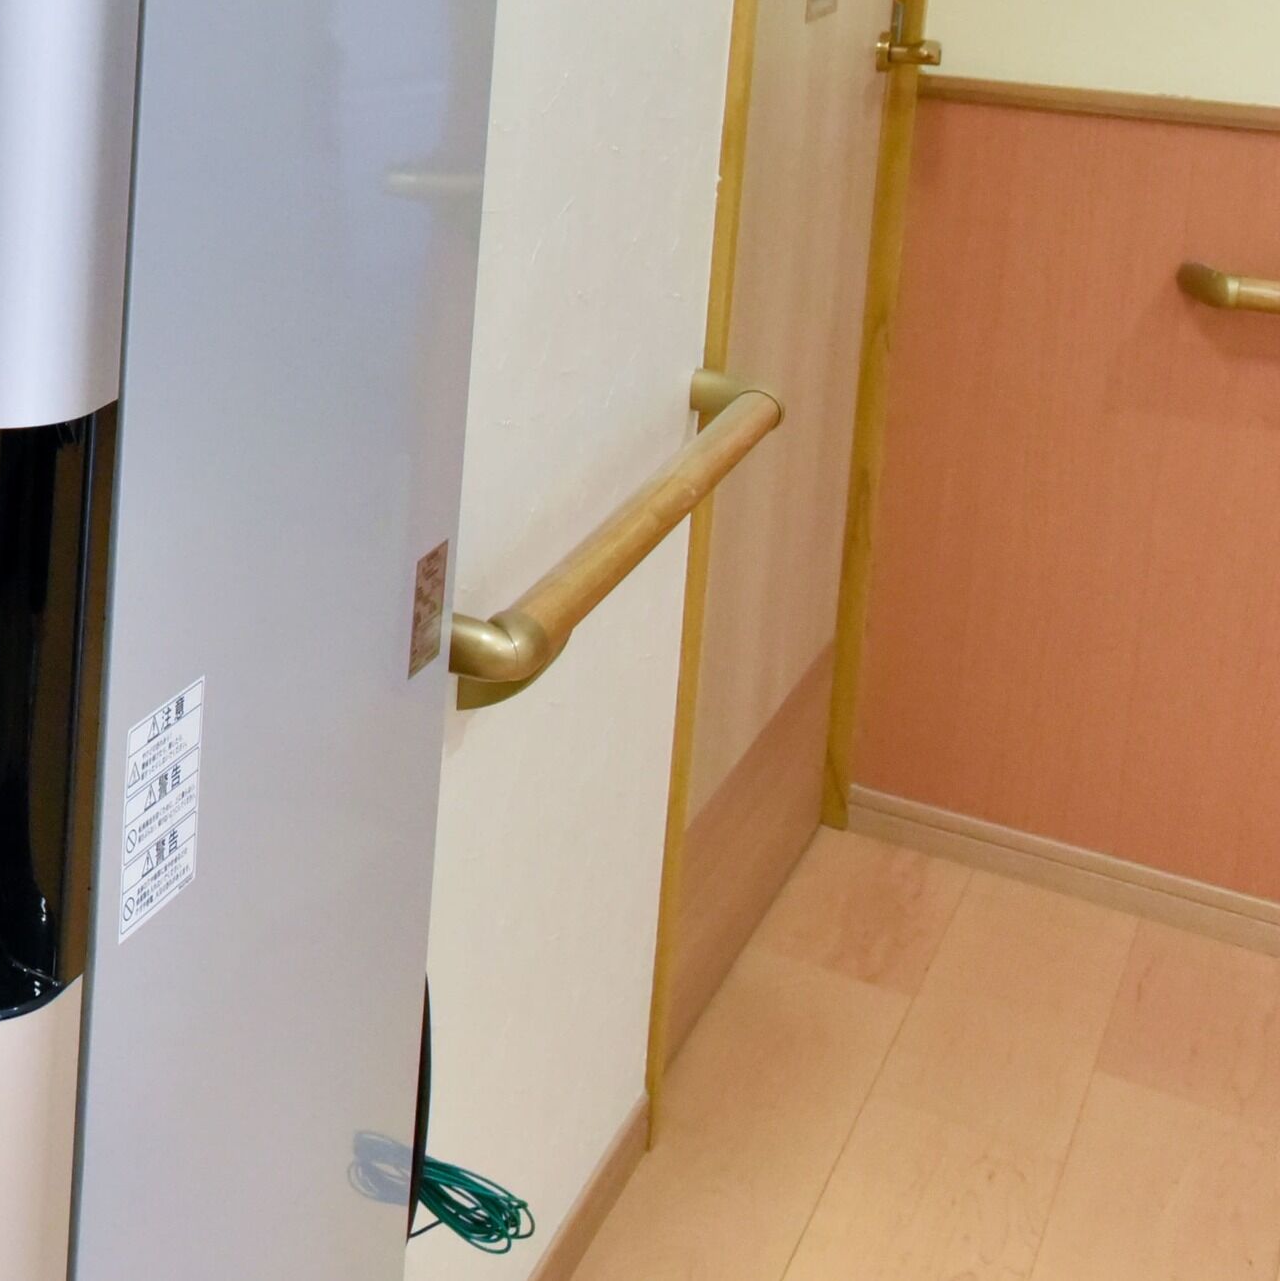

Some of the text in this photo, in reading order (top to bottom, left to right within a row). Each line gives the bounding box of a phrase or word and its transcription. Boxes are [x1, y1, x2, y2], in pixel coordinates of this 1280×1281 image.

[160, 696, 186, 731] 注意
[157, 764, 182, 800] 警告
[155, 829, 179, 863] 警告
